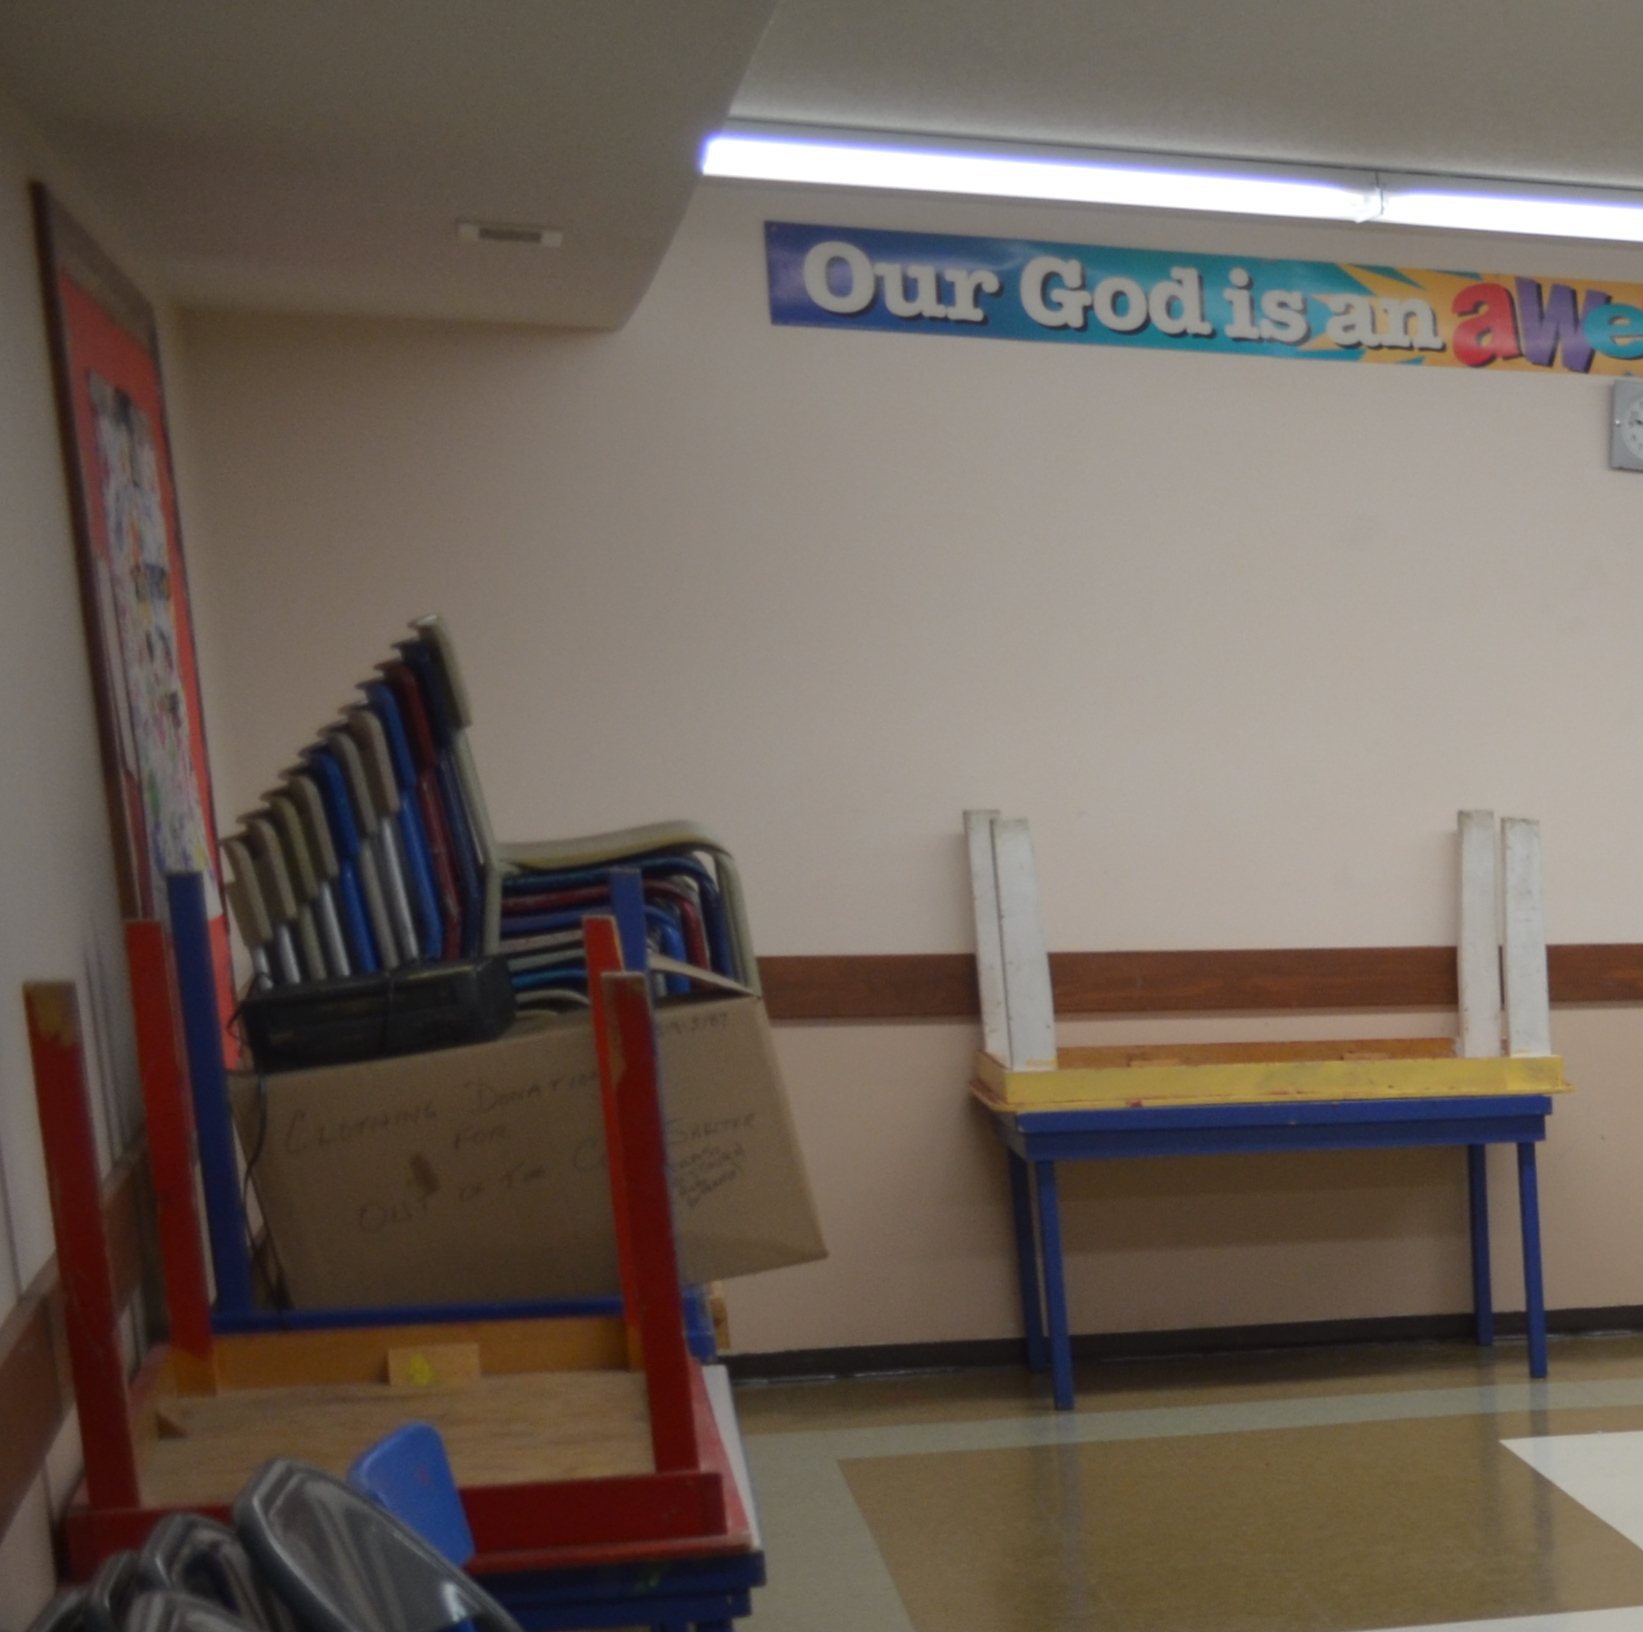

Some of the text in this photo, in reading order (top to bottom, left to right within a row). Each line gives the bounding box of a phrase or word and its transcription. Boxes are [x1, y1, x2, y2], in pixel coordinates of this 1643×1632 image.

[803, 240, 1000, 323] Our
[1020, 255, 1212, 337] God
[1225, 267, 1310, 343] is
[1326, 293, 1445, 352] an
